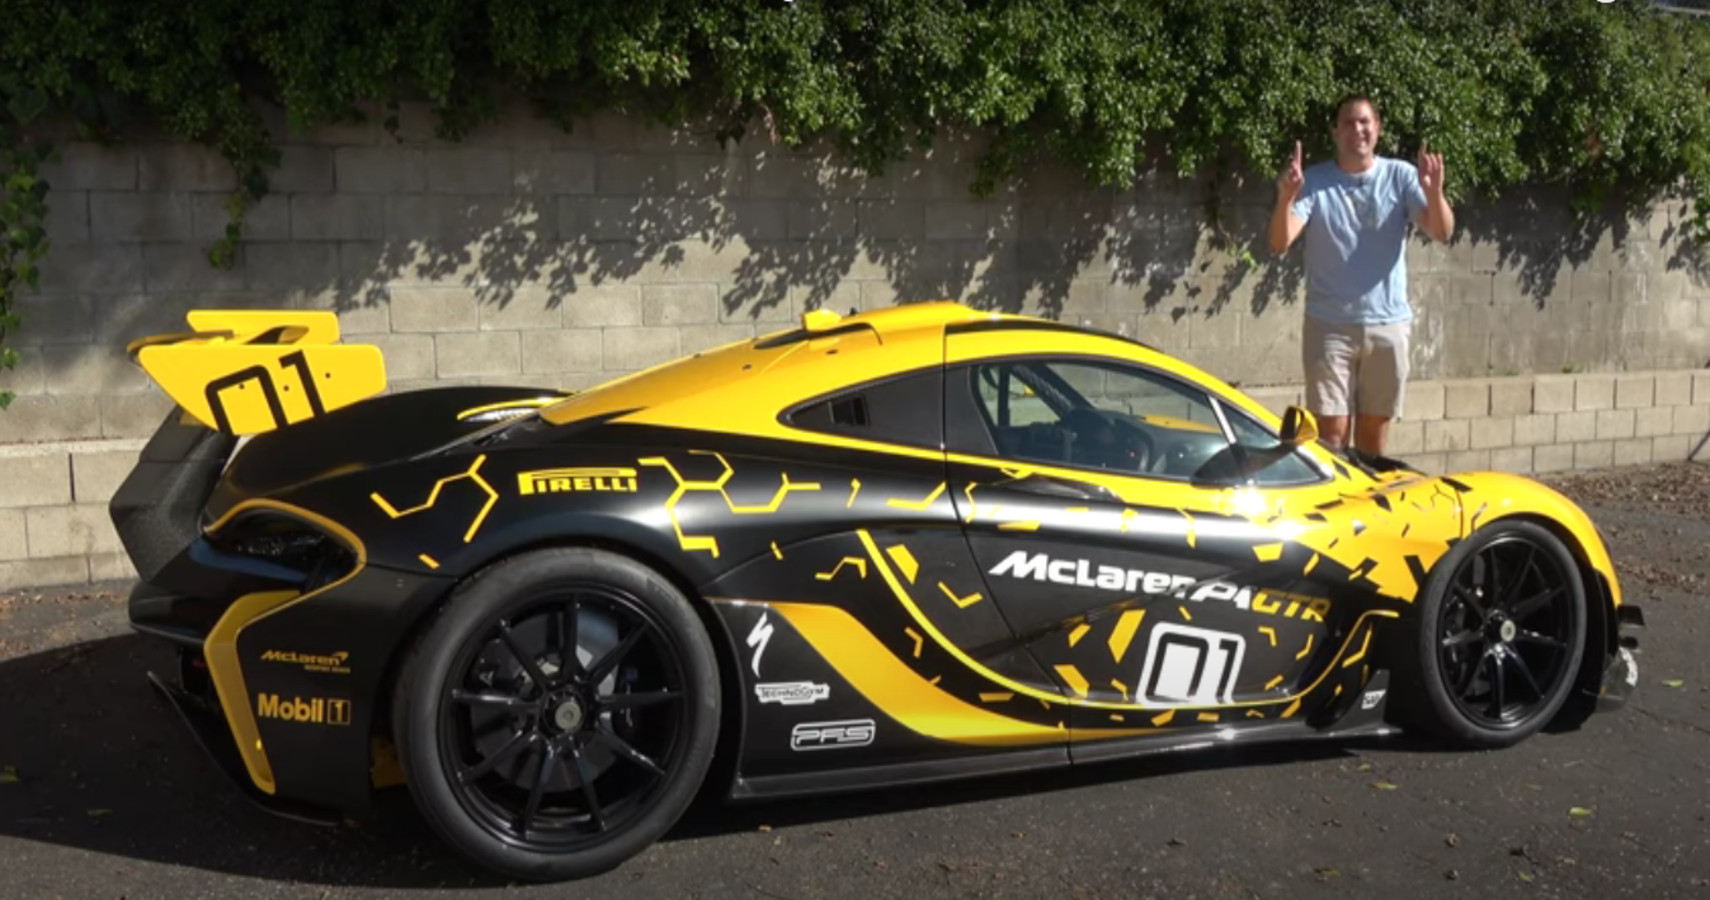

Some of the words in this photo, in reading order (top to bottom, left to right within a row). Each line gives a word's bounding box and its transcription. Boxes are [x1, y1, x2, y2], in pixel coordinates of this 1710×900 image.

[205, 350, 326, 435] 01
[518, 467, 637, 495] PIRELLI
[988, 550, 1196, 598] McLaren
[260, 650, 341, 666] McLaren
[1144, 631, 1240, 704] 01
[258, 692, 323, 722] Mobil
